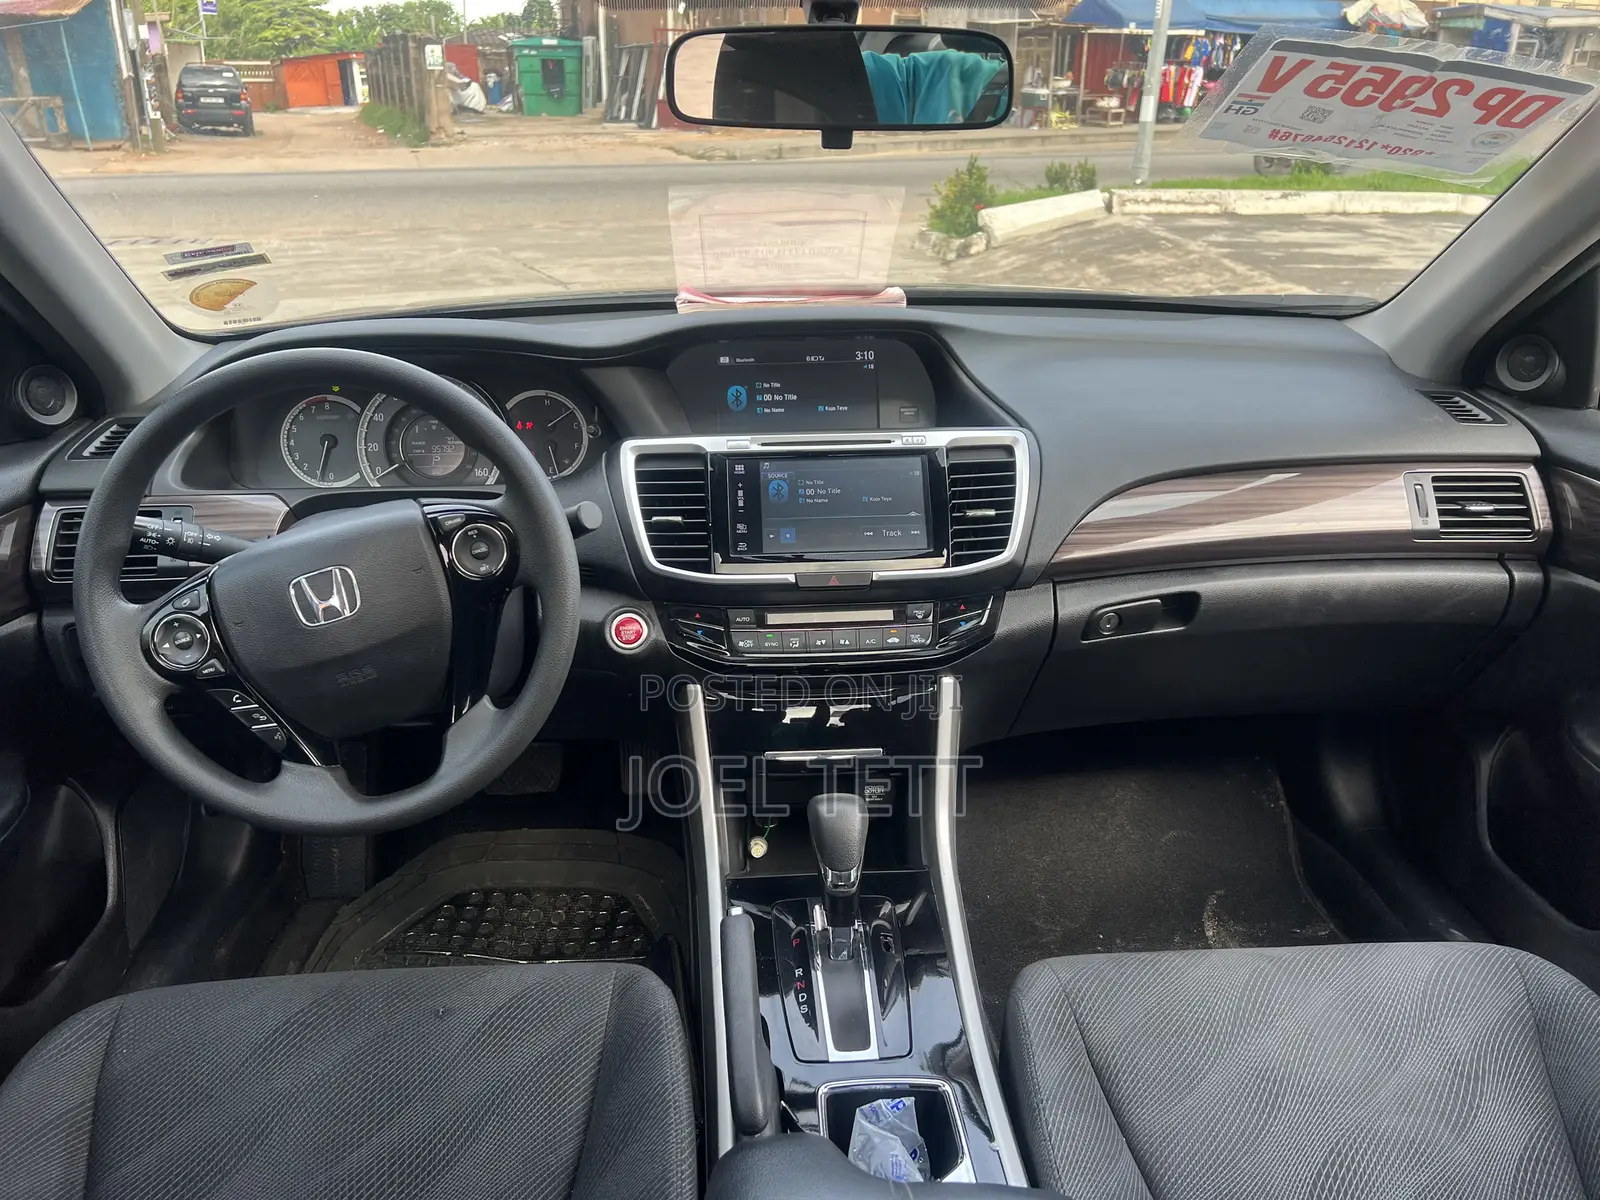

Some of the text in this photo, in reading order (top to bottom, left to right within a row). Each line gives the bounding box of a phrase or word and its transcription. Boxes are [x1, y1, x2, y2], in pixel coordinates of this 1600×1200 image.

[855, 350, 875, 361] 3:10
[310, 405, 316, 414] 7
[324, 402, 330, 410] 8
[299, 413, 304, 421] 6
[373, 413, 384, 421] 40
[291, 425, 297, 433] 5
[573, 422, 579, 430] C
[368, 442, 378, 452] 20
[294, 452, 299, 460] 3
[303, 463, 308, 471] 2
[376, 466, 381, 475] 0
[549, 466, 554, 474] E
[329, 472, 334, 480] 0
[474, 468, 489, 477] 160
[805, 488, 815, 496] 00
[817, 487, 827, 495] No
[882, 529, 902, 537] Track
[792, 938, 801, 948] P
[795, 967, 803, 978] R
[796, 980, 806, 989] N
[798, 992, 807, 1002] D
[800, 1004, 809, 1014] S
